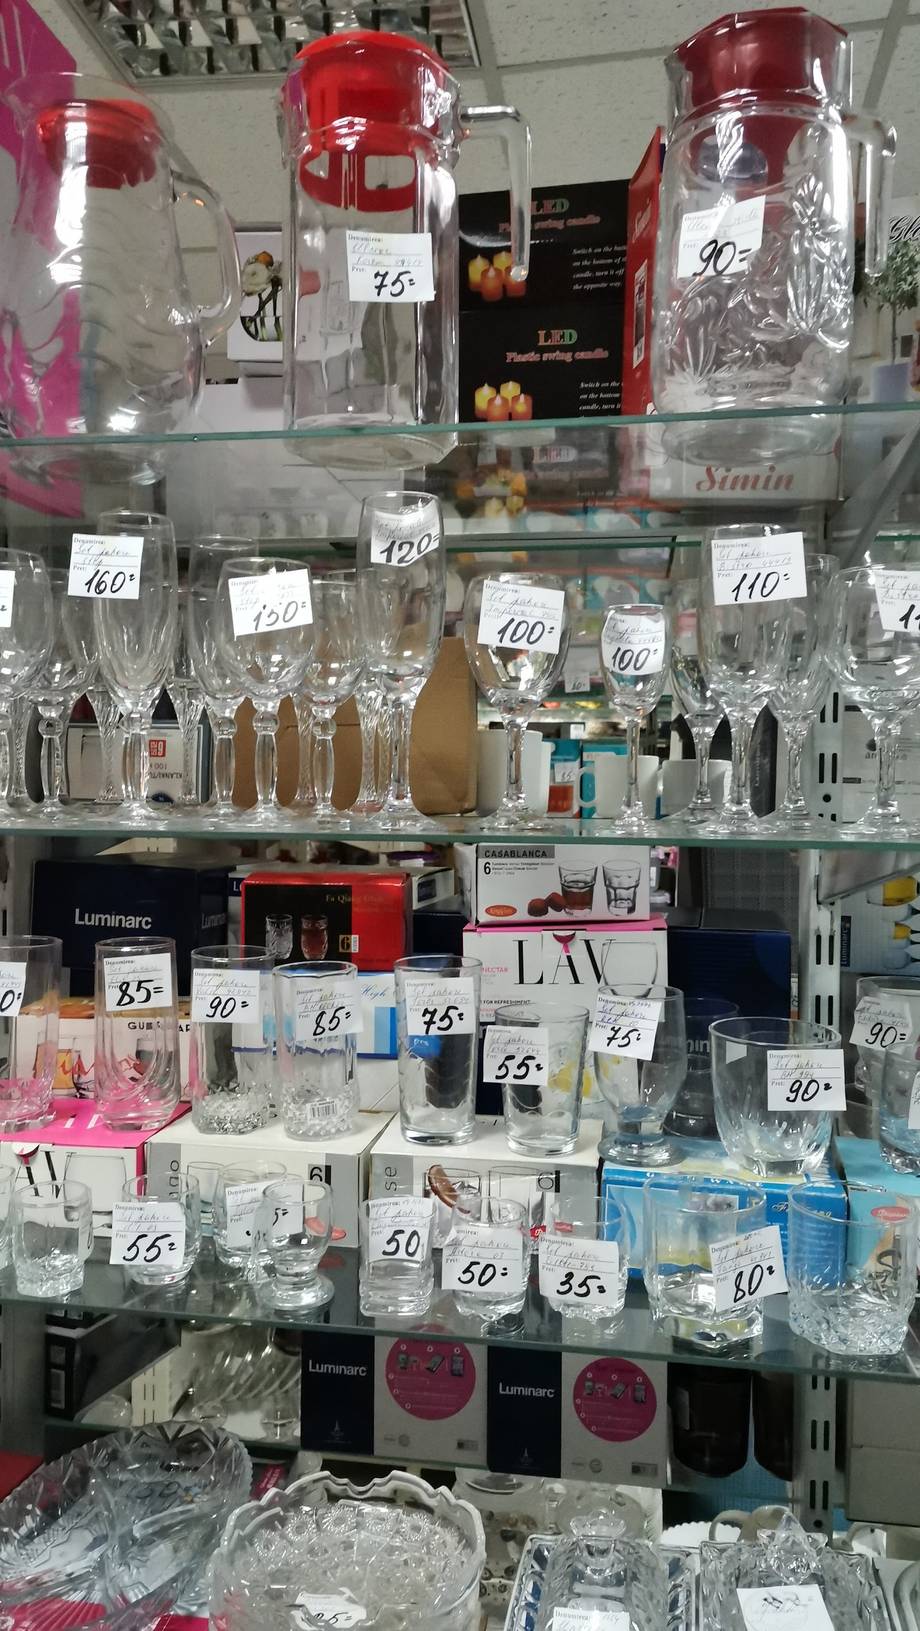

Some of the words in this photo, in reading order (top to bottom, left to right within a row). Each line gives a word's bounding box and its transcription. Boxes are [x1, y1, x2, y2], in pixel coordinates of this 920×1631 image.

[538, 329, 577, 346] LED
[506, 351, 541, 363] Plastic
[542, 350, 573, 362] swing
[574, 348, 609, 360] candle
[696, 464, 795, 492] Simin
[484, 850, 547, 858] CASABLANCA
[484, 862, 491, 875] 6
[233, 881, 243, 891] L
[75, 908, 152, 929] Luminarc
[512, 931, 616, 985] LAV
[116, 980, 164, 1006] 85=
[206, 996, 249, 1018] 90=
[313, 1006, 351, 1036] 85=
[865, 1022, 906, 1048] 90=
[382, 1230, 420, 1257] 50
[308, 1359, 367, 1377] Luminarc
[499, 1382, 555, 1398] Luminarc
